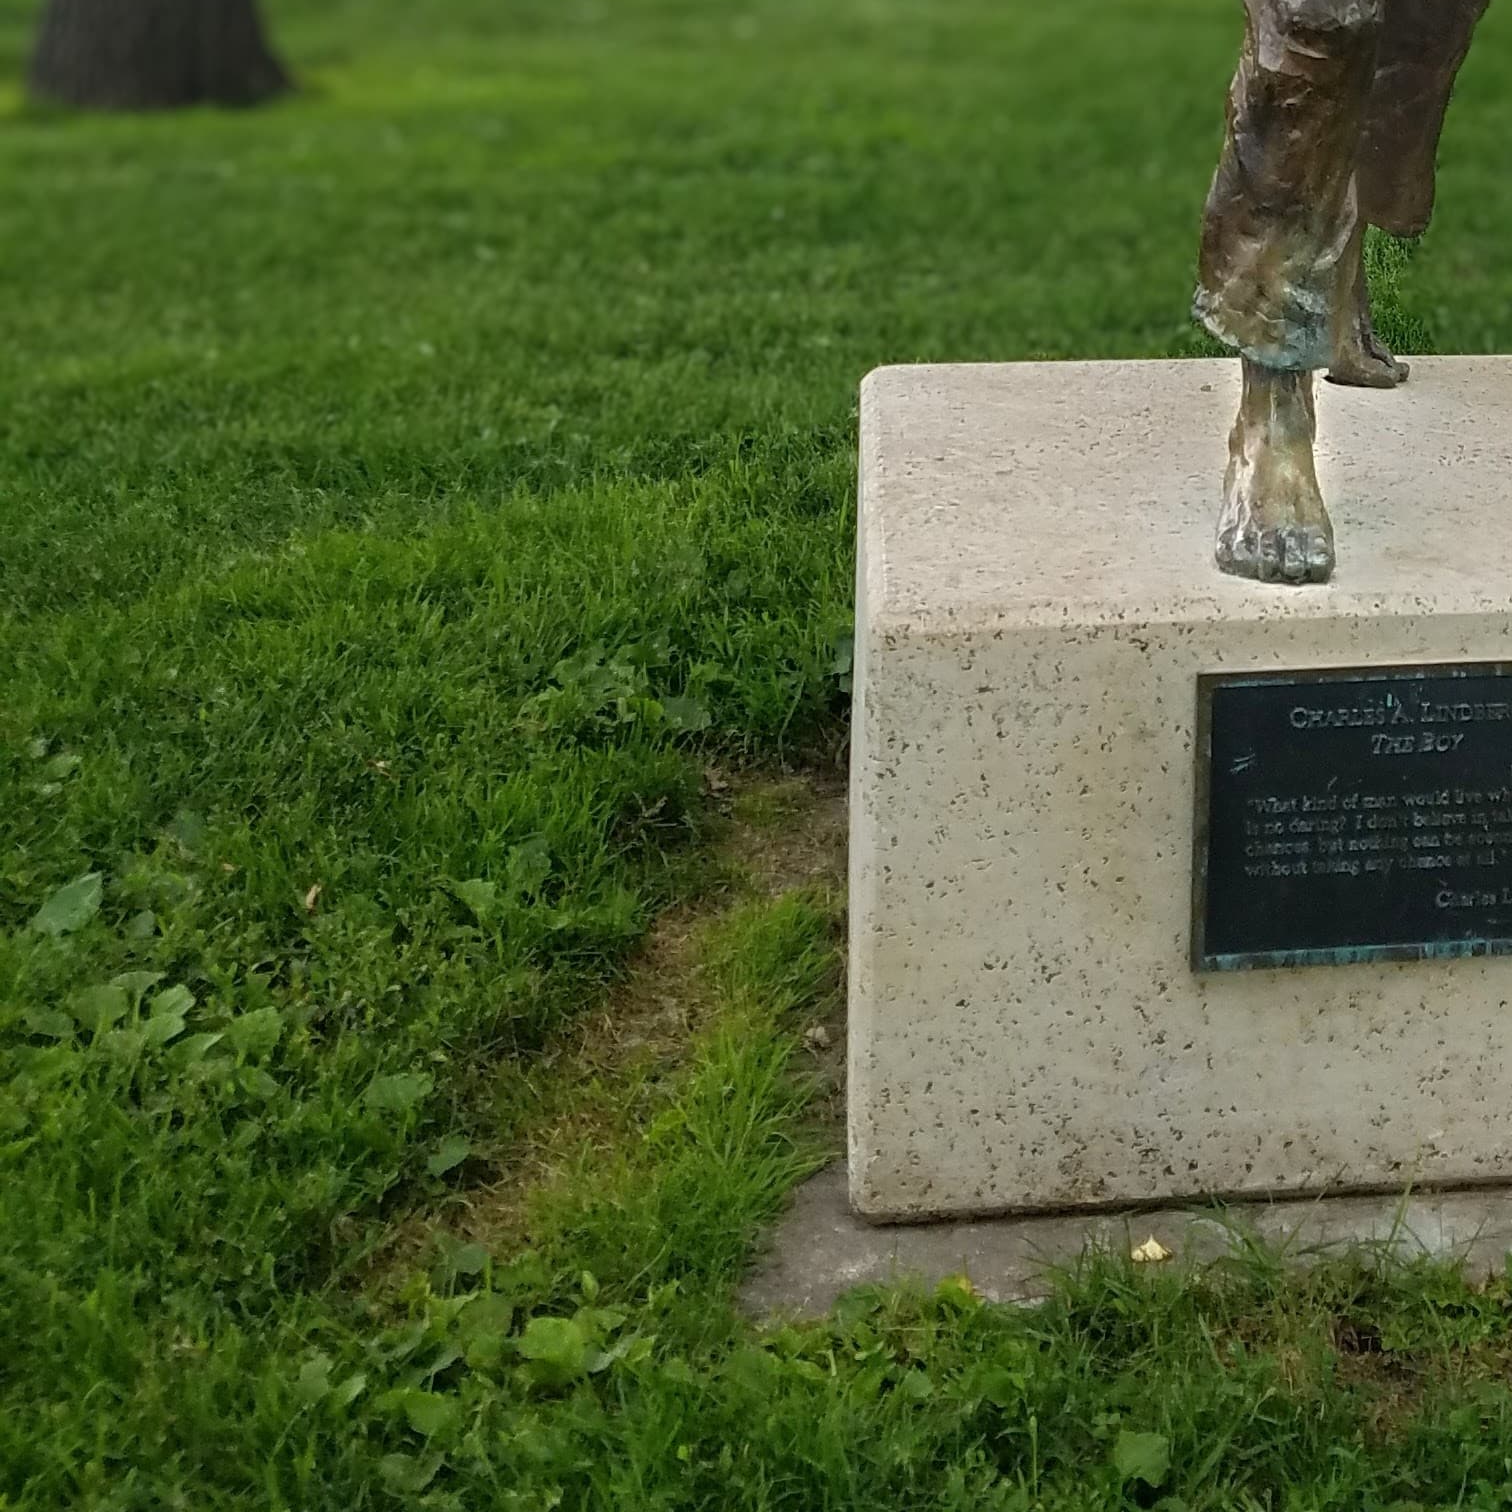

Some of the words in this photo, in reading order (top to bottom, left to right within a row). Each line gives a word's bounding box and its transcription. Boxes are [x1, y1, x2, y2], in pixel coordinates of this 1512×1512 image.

[1290, 705, 1385, 727] CHARLES
[1390, 698, 1414, 724] A.
[1371, 734, 1414, 755] THE
[1419, 732, 1465, 752] BOY
[1302, 793, 1337, 812] kind
[1343, 793, 1359, 810] of
[1402, 790, 1450, 807] would
[1264, 821, 1285, 834] no
[1356, 813, 1363, 830] I
[1414, 835, 1440, 850] can
[1245, 858, 1308, 877] without
